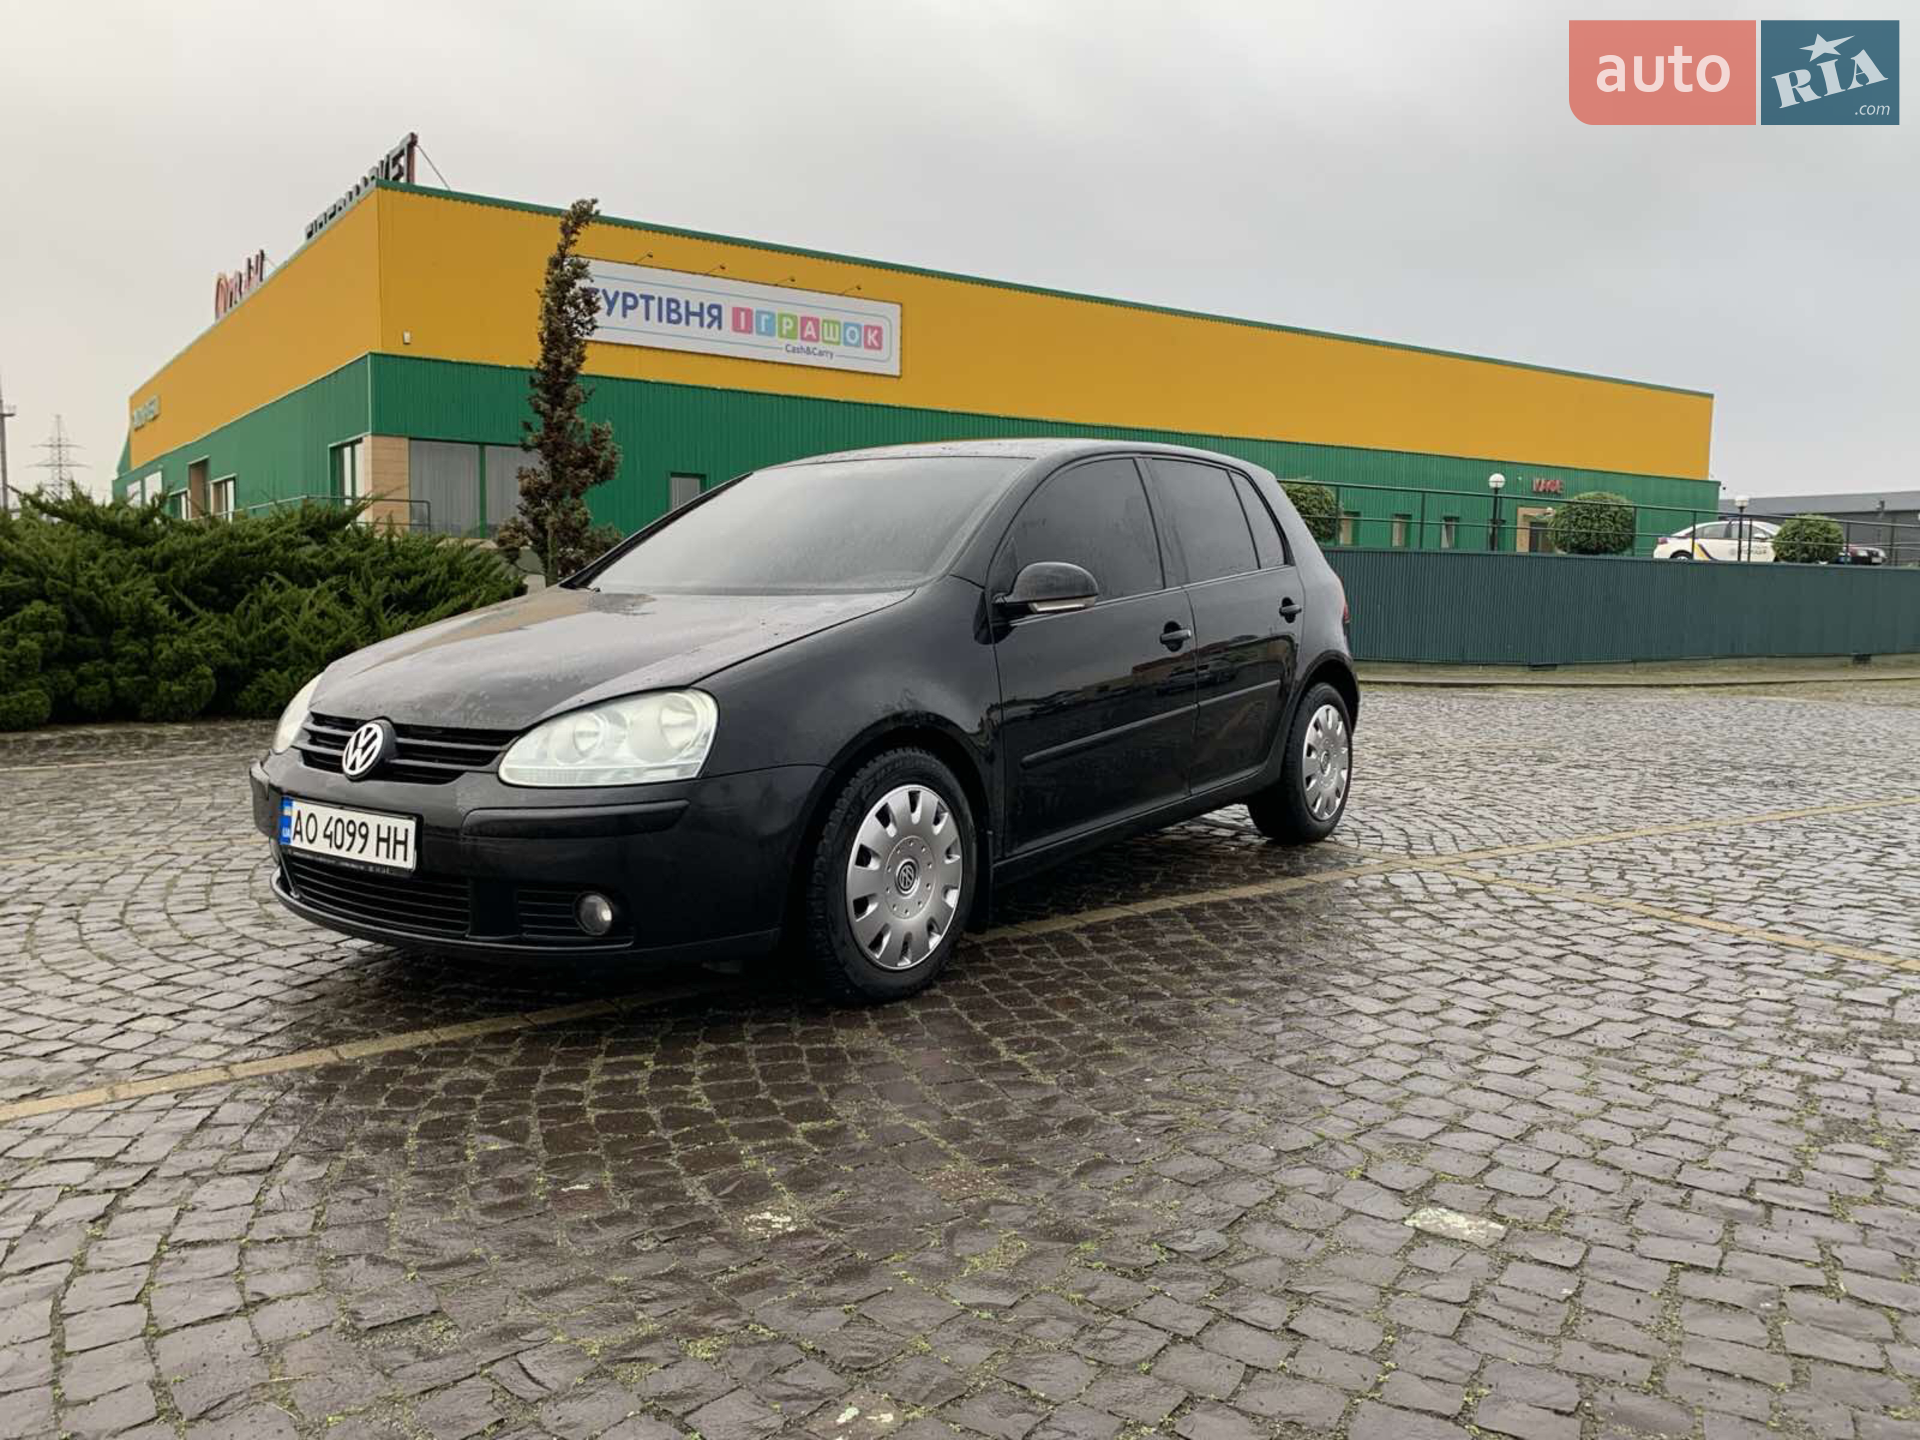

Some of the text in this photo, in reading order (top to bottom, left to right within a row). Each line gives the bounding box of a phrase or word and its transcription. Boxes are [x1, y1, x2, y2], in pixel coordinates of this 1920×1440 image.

[736, 307, 882, 349] ІГРАШОК
[784, 343, 834, 360] Cash&Carry
[323, 815, 369, 854] 4099
